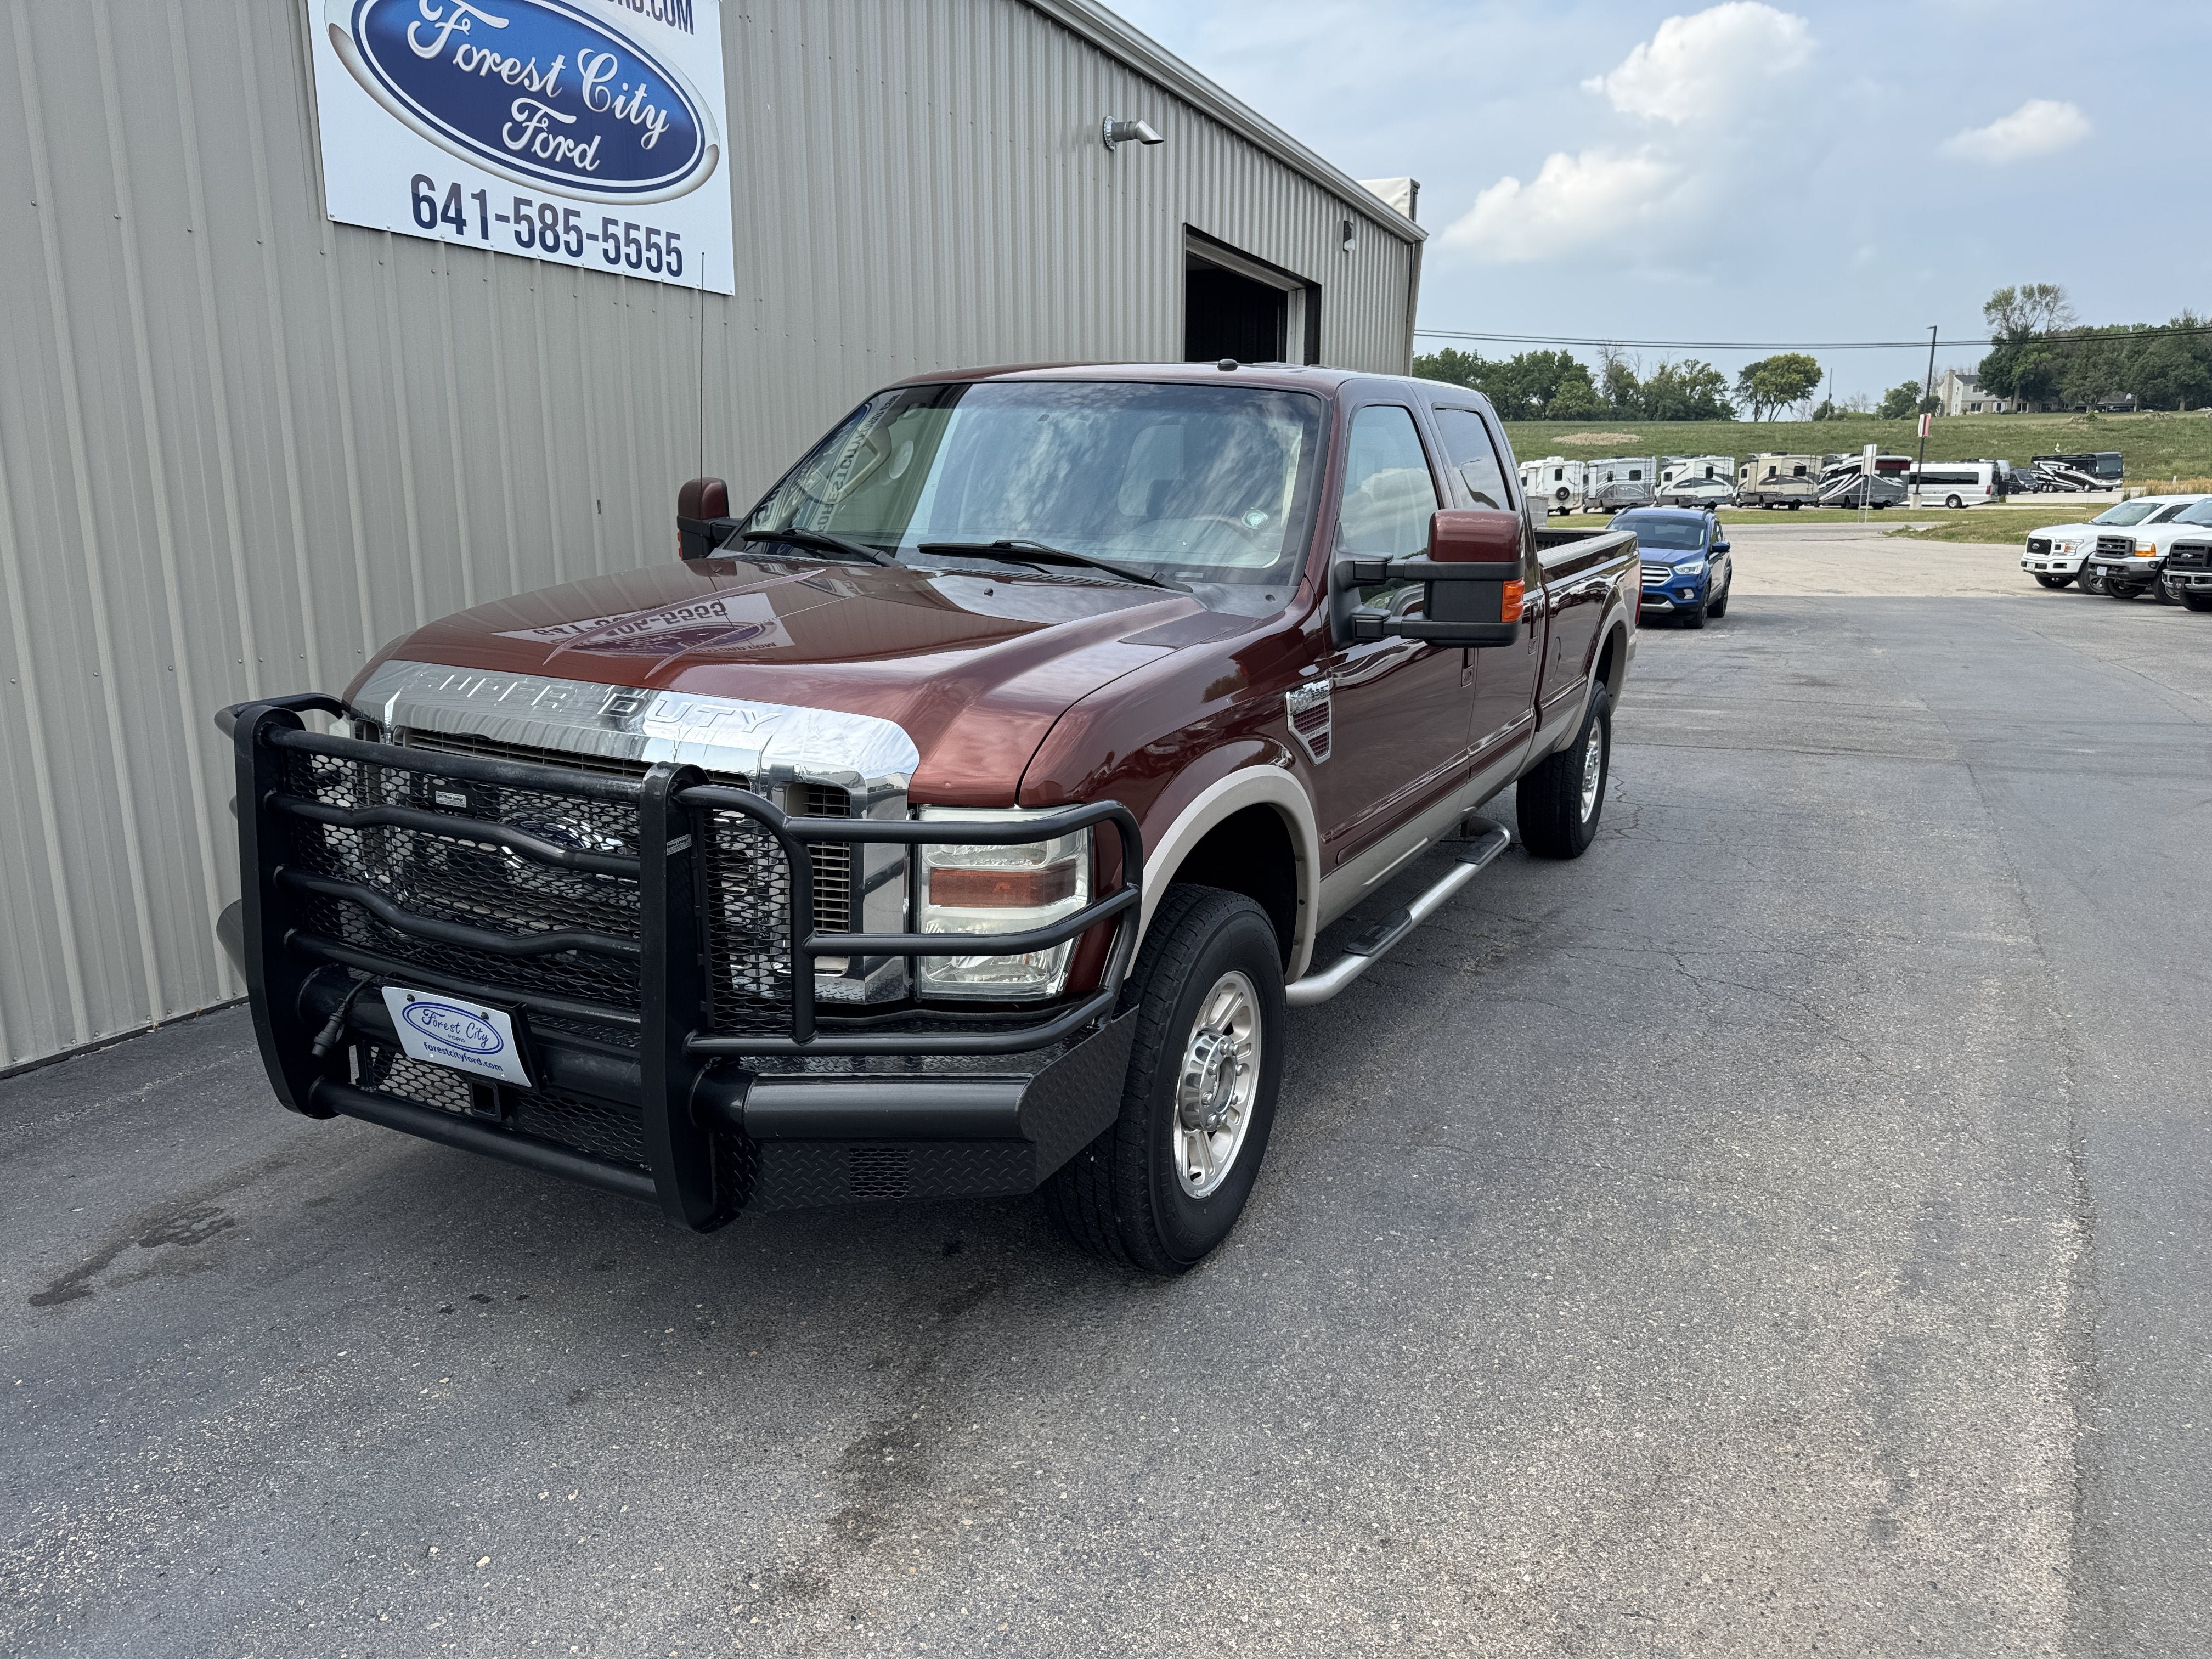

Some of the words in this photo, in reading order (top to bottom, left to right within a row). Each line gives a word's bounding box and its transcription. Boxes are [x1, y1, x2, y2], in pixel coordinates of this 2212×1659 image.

[407, 0, 566, 98] Forest
[577, 47, 670, 151] City
[502, 97, 601, 172] Ford
[410, 174, 682, 278] 641-585-5555
[597, 693, 783, 734] DUTY
[421, 1009, 460, 1034] Forest
[466, 1022, 489, 1048] City
[448, 1034, 465, 1043] FORD
[424, 1041, 504, 1072] forestcityford.com
